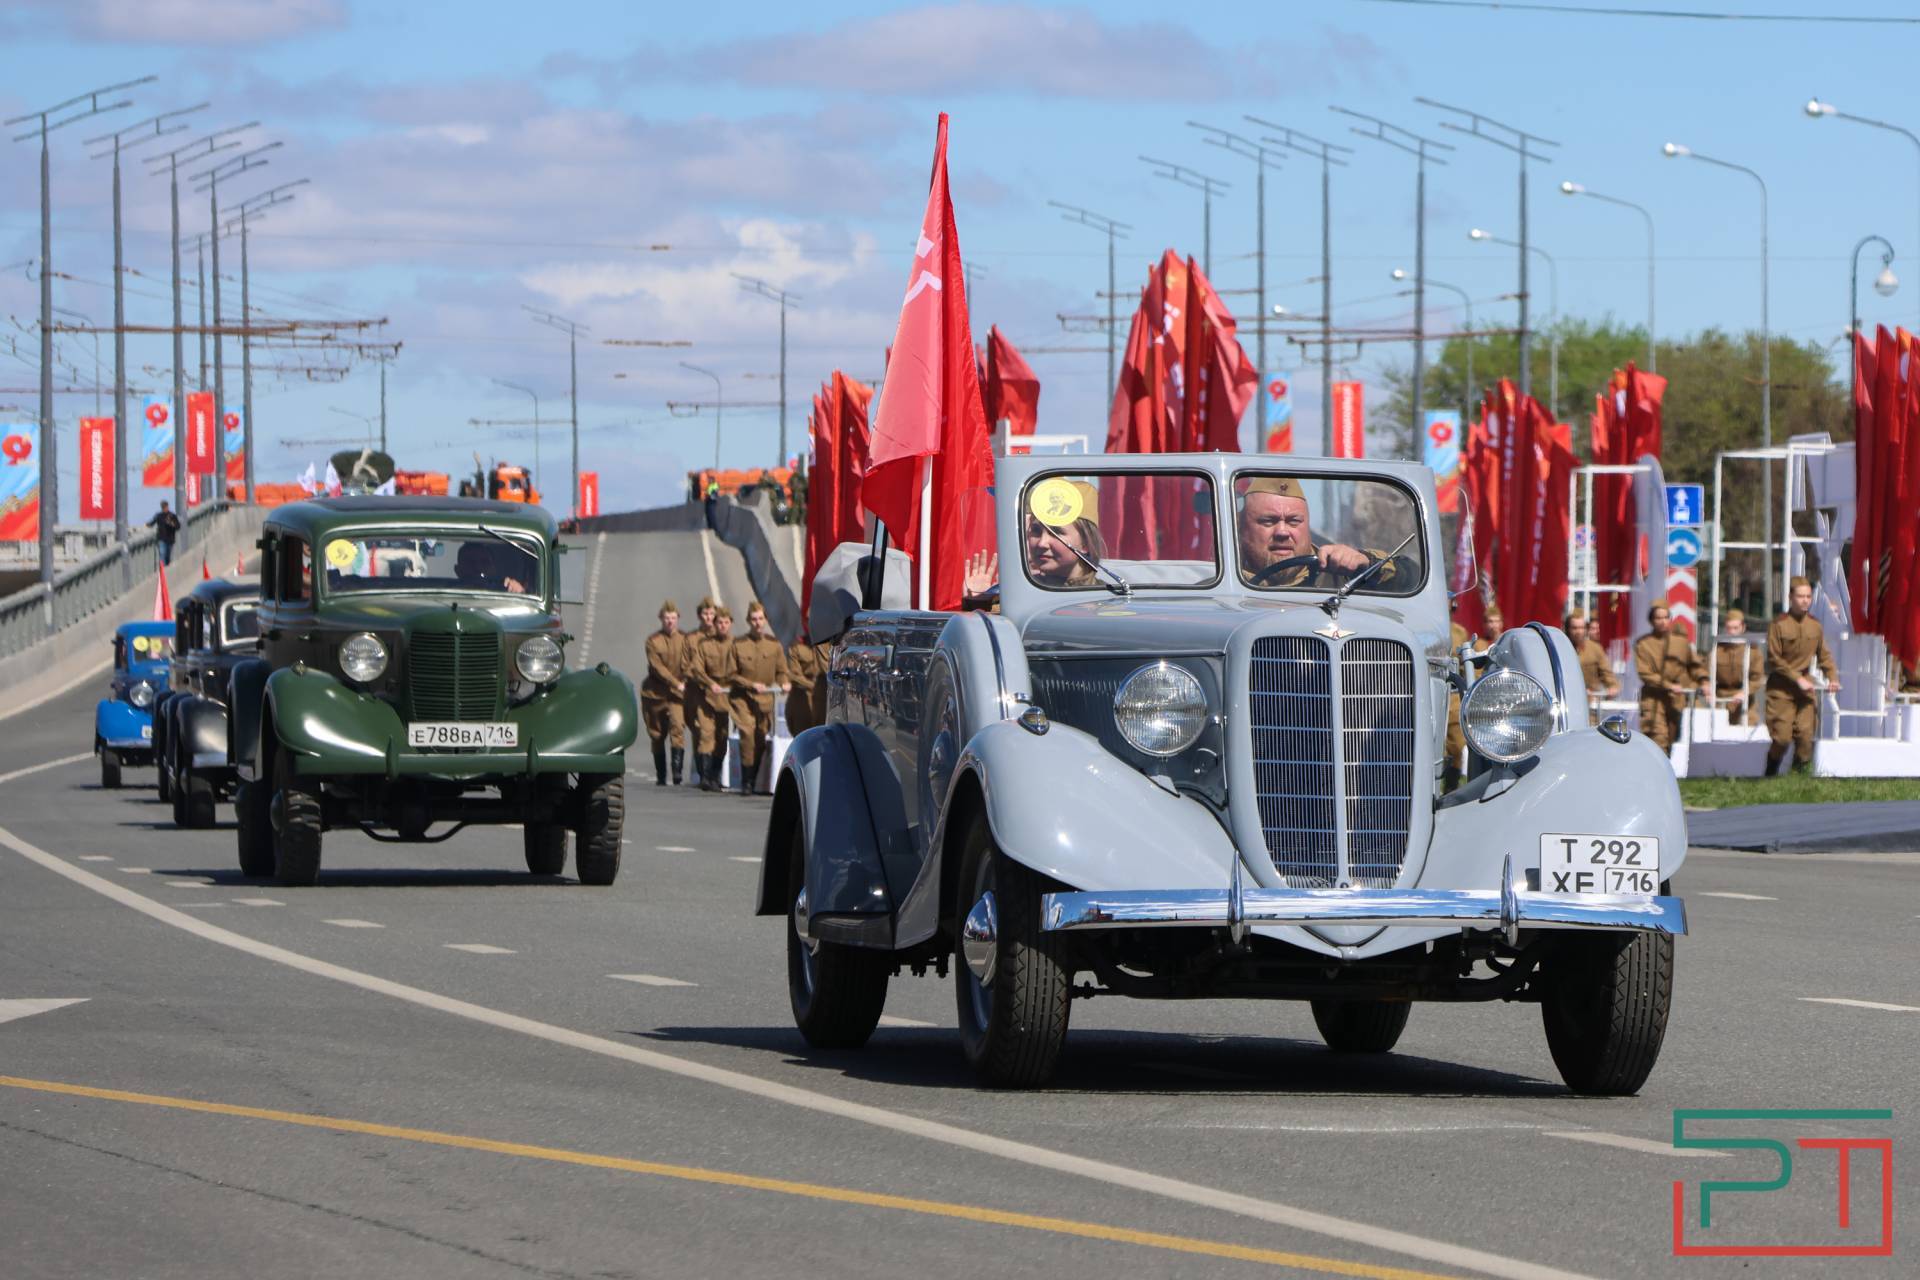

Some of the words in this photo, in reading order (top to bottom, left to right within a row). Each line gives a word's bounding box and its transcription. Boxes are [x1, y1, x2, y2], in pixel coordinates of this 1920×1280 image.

[487, 726, 513, 739] 716
[1590, 839, 1641, 865] 292
[1611, 871, 1653, 893] 716
